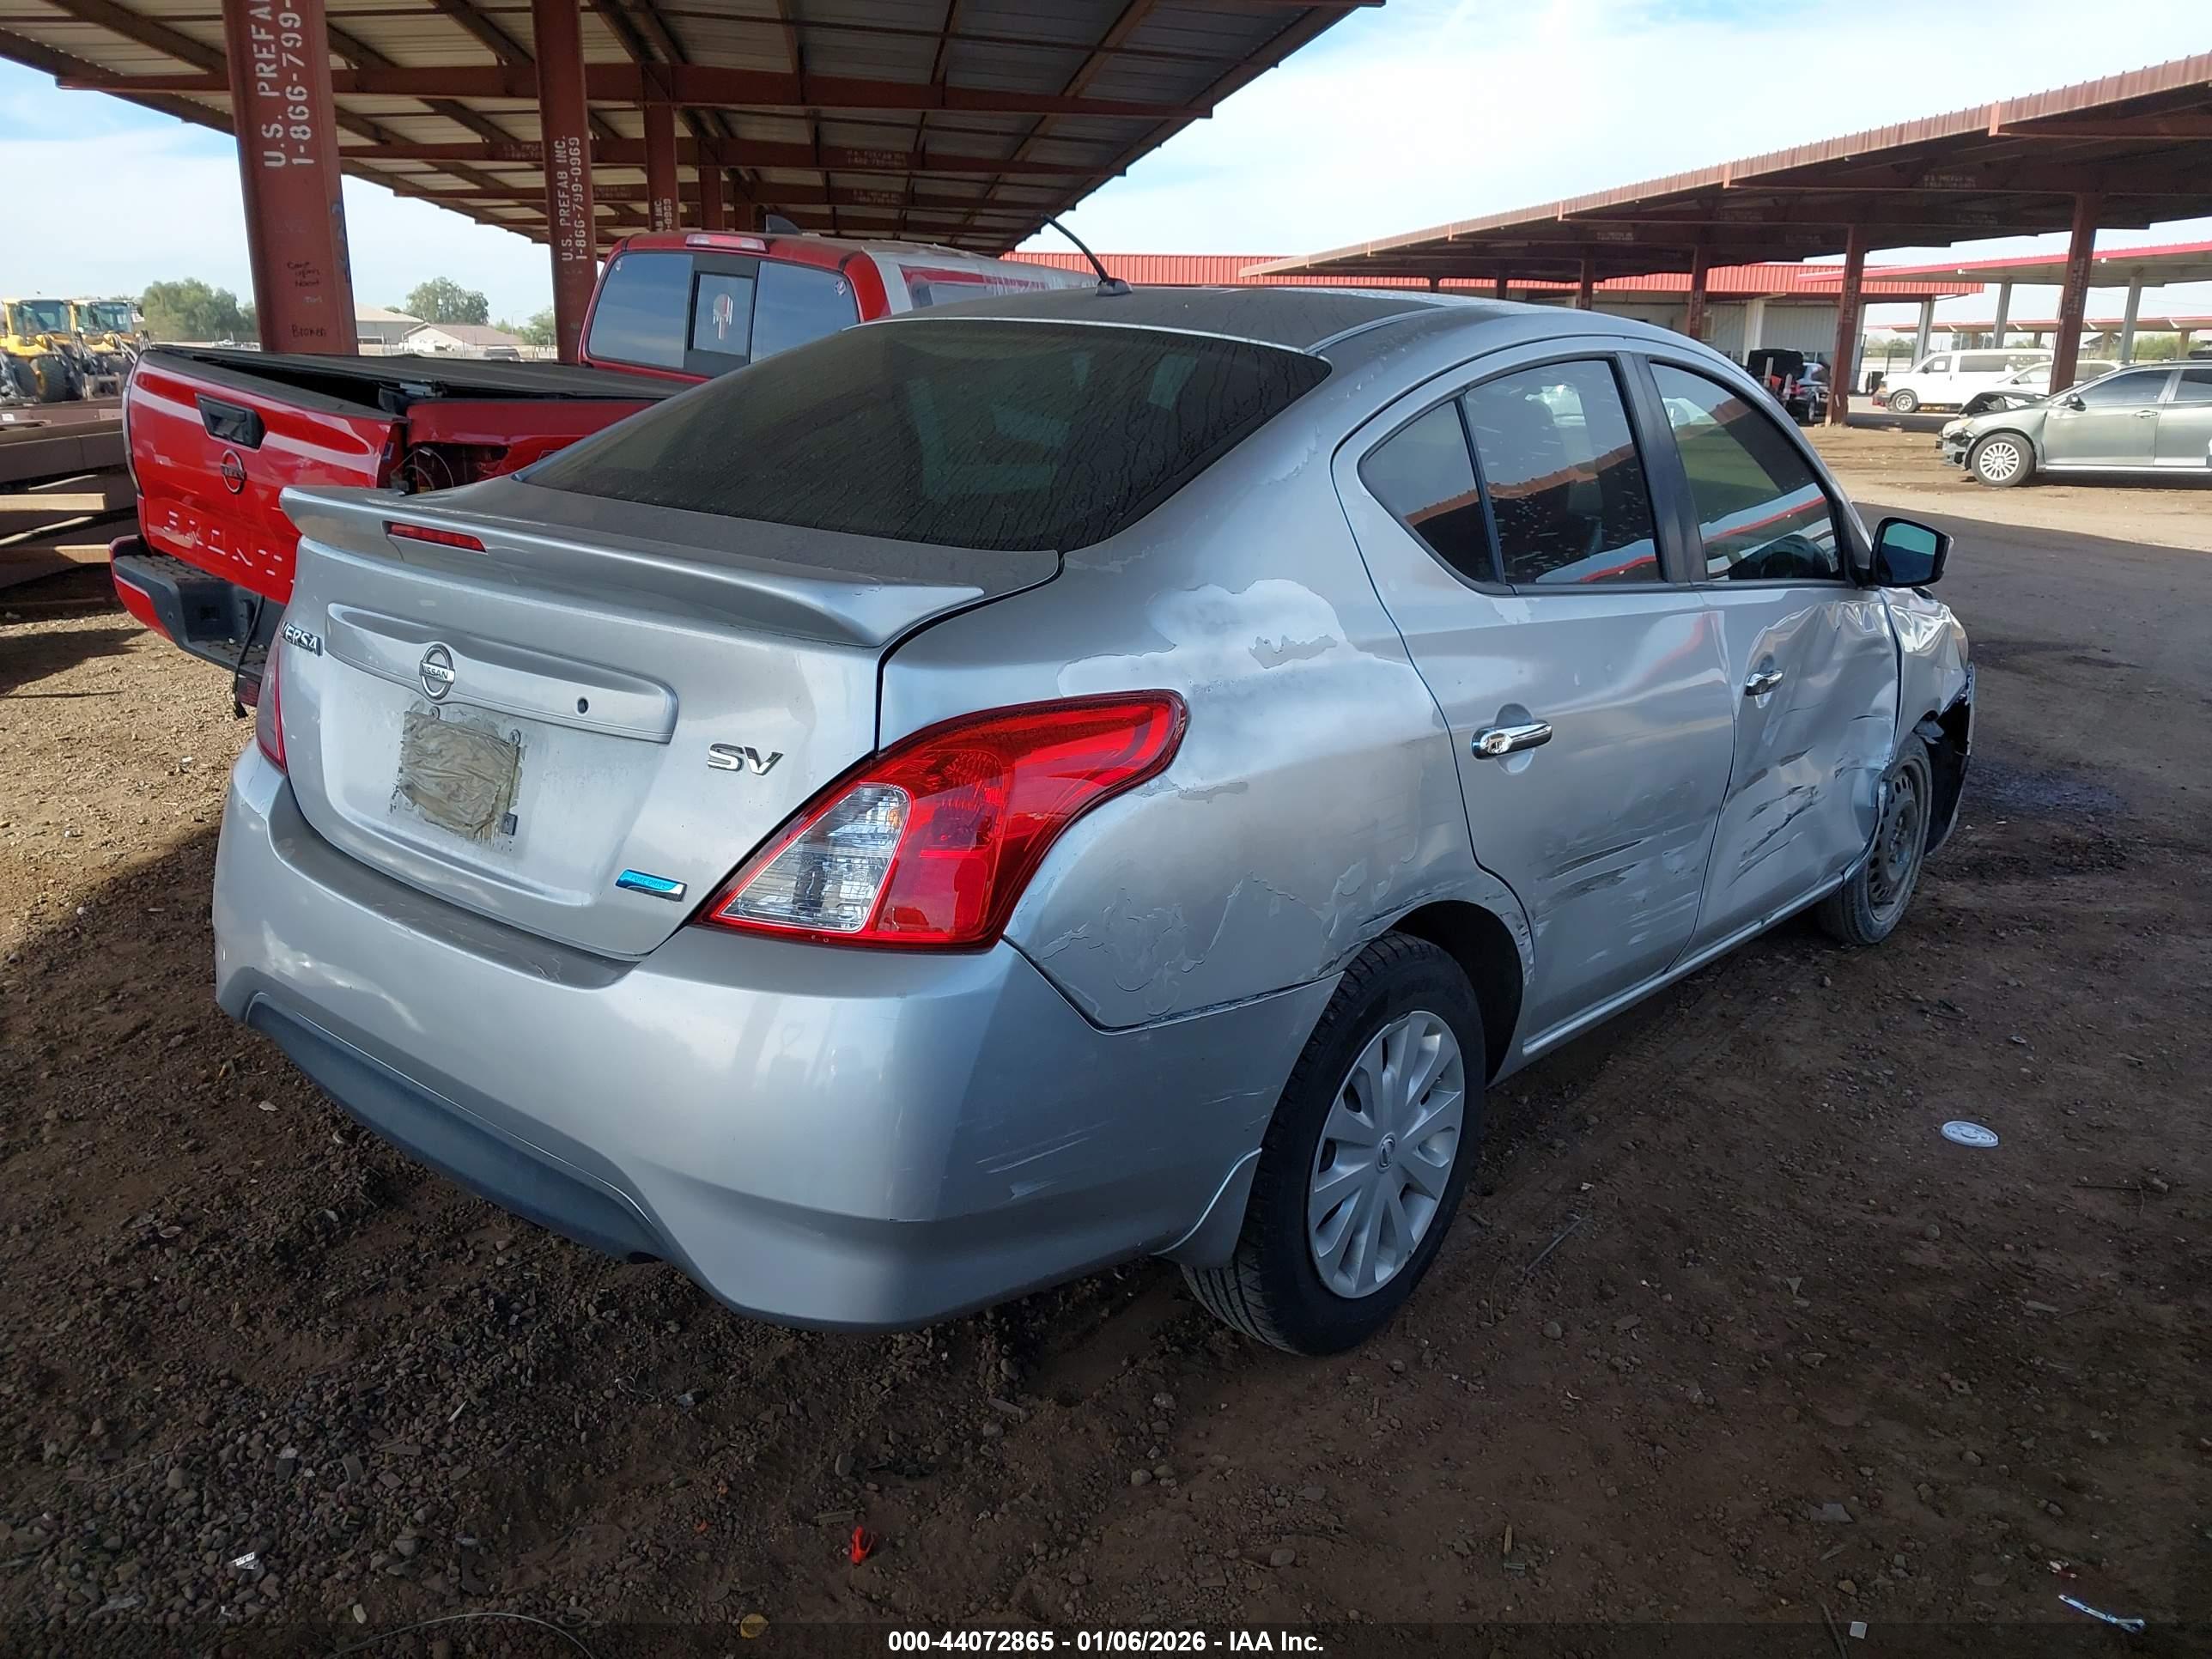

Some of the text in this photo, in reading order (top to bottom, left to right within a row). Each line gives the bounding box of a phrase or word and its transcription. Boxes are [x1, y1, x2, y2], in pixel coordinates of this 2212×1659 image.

[248, 0, 287, 167] U.S. PREFA
[554, 135, 568, 163] INC.
[556, 170, 571, 227] PREFAB
[568, 137, 587, 259] 1-866-799-0969
[561, 234, 574, 261] U.S.
[707, 743, 784, 776] SV
